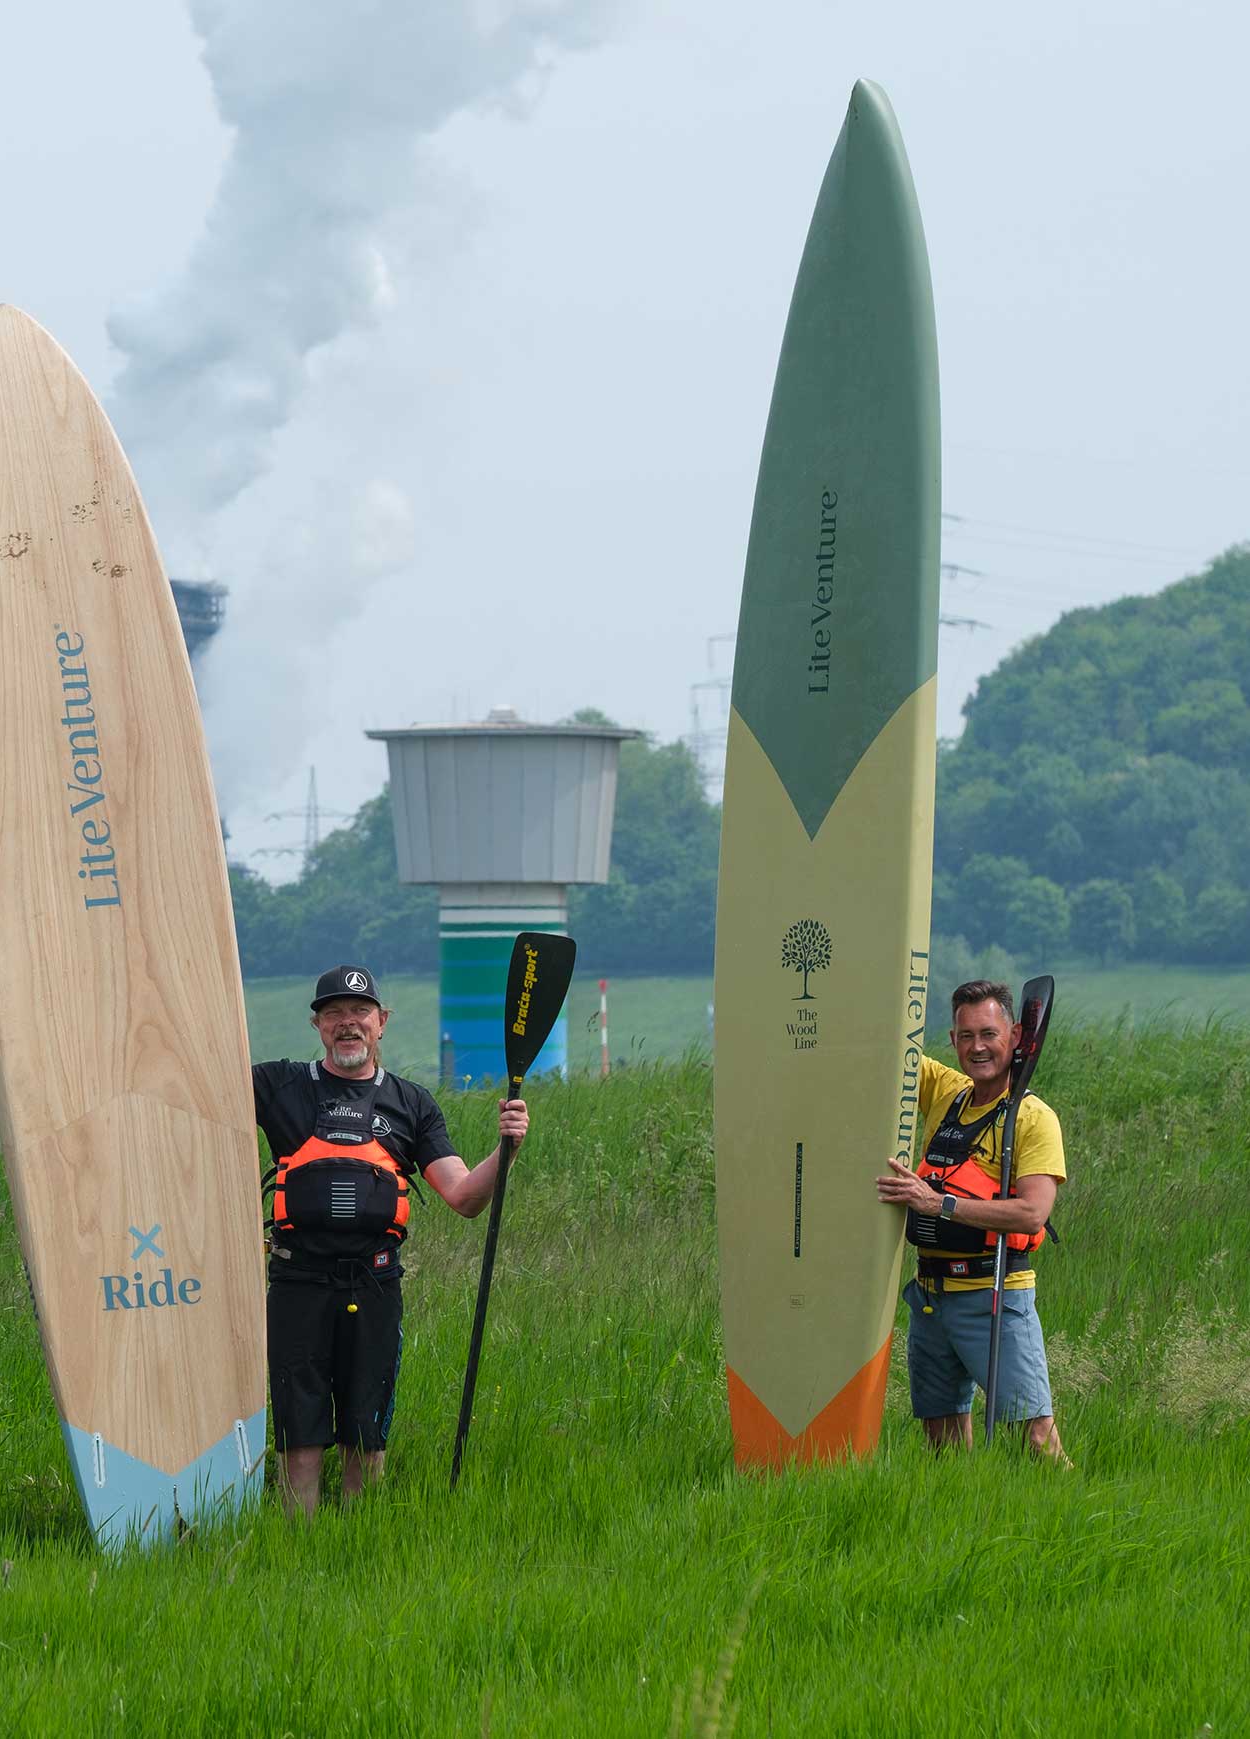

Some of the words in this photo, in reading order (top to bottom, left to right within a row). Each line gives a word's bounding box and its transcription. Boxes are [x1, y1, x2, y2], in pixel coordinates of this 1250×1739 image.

[797, 1008, 818, 1022] The
[786, 1022, 818, 1036] Wood
[794, 1037, 818, 1050] Line
[328, 1110, 364, 1119] Venture
[100, 1268, 203, 1312] Ride
